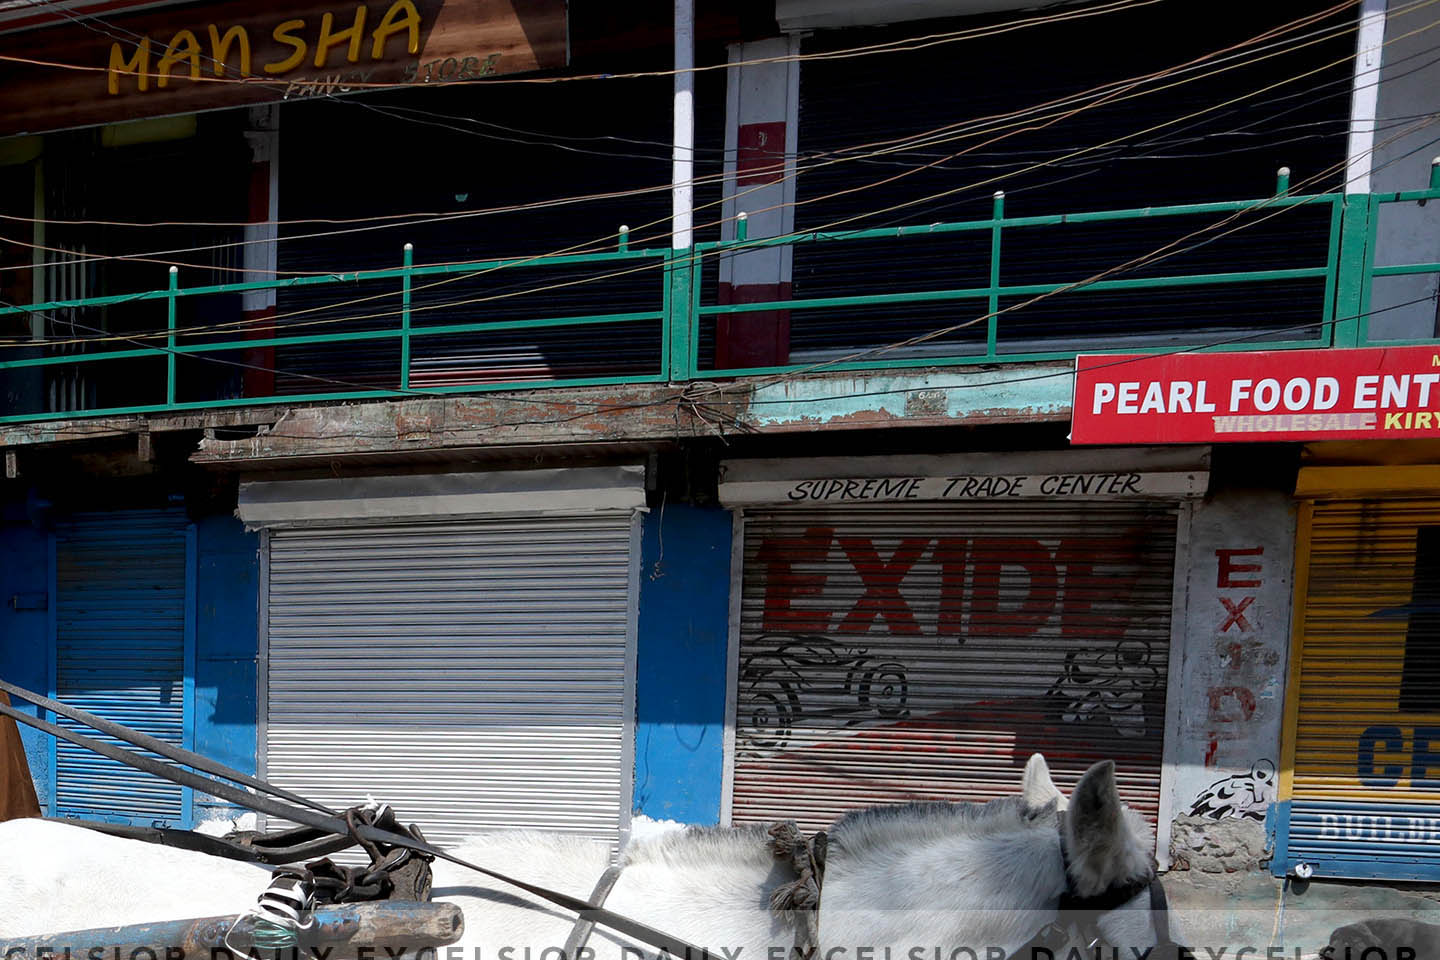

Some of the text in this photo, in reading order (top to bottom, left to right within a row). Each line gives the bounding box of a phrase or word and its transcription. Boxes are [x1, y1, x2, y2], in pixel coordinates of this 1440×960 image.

[108, 0, 422, 95] MANSHA
[1092, 381, 1216, 415] PEARL
[1229, 377, 1340, 412] FOOD
[1214, 413, 1377, 433] WHOLESALE
[788, 472, 1143, 501] SUPREME TRADE CENTER
[757, 526, 1150, 637] EXIDE
